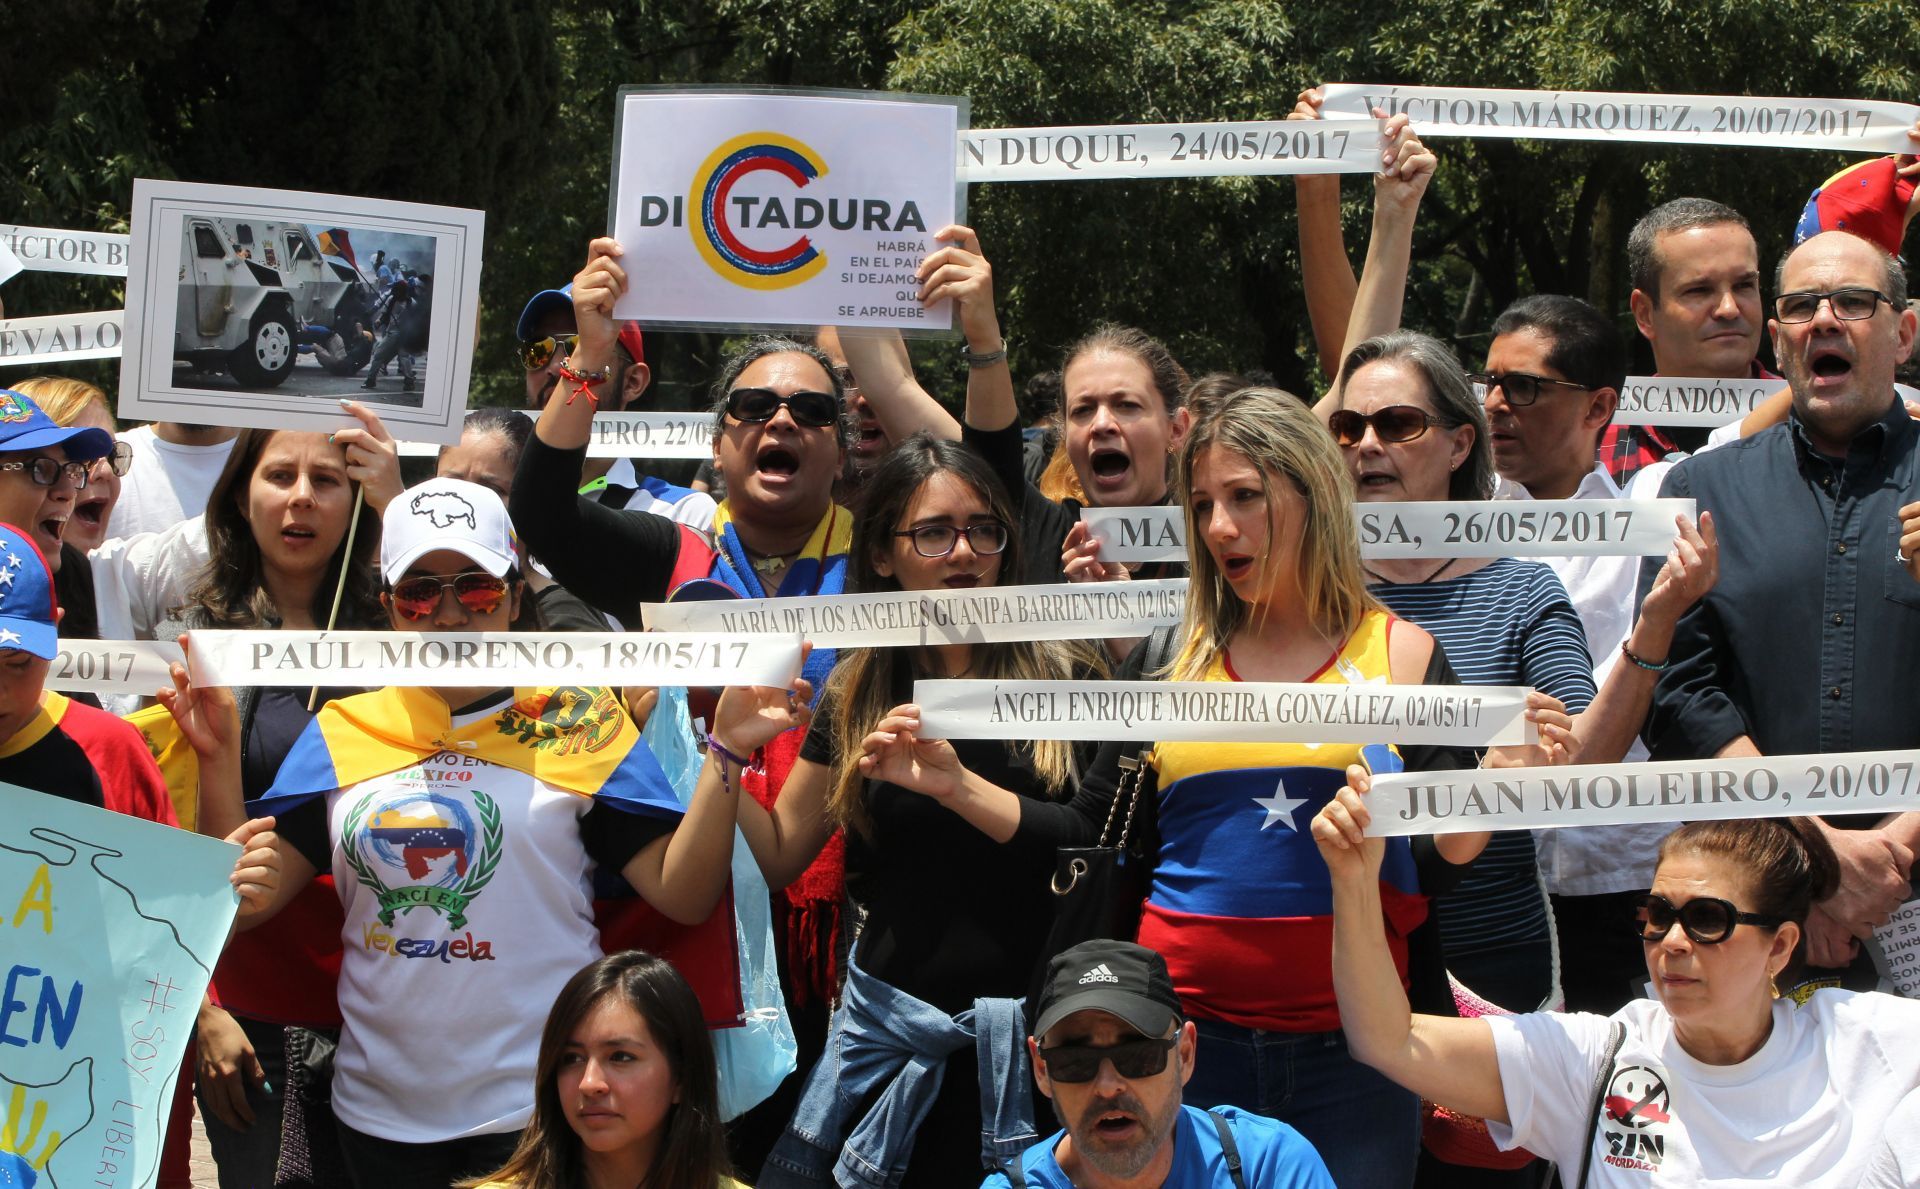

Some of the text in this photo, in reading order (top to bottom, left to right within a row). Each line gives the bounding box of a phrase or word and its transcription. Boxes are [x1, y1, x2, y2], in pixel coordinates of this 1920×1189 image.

[1363, 88, 1873, 137] VÍCTOR MÁRQUEZ, 20/07/2017
[1000, 134, 1148, 169] DUQUE,
[1171, 130, 1350, 160] 24/05/2017
[105, 242, 130, 267] B
[877, 240, 926, 252] HABRÁ
[841, 273, 853, 282] SI
[850, 257, 869, 267] EN
[874, 258, 890, 268] EL
[838, 306, 925, 318] SE APRUEBE
[896, 291, 925, 301] QU
[0, 321, 122, 357] ÉVALO
[664, 421, 713, 446] 22/0
[1118, 511, 1633, 550] MA SA, 26/05/2017
[720, 603, 783, 633] MARÍA
[810, 606, 845, 633] LOS
[850, 599, 930, 631] ANGELES
[933, 595, 1014, 627] GUANIPA
[1016, 591, 1135, 624] BARRIENTOS,
[56, 650, 136, 682] 2017
[250, 633, 749, 673] PAÚL MORENO, 18/05/17
[990, 685, 1482, 732] ÁNGEL ENRIQUE MOREIRA GONZÁLEZ, 02/05/17
[1399, 762, 1920, 820] JUAN MOLEIRO, 20/07
[382, 887, 463, 910] NACÍ EN
[363, 922, 496, 964] Venezuela
[1078, 974, 1119, 985] adidas
[1604, 1155, 1658, 1173] MORDAZA
[1605, 1131, 1664, 1165] SIN
